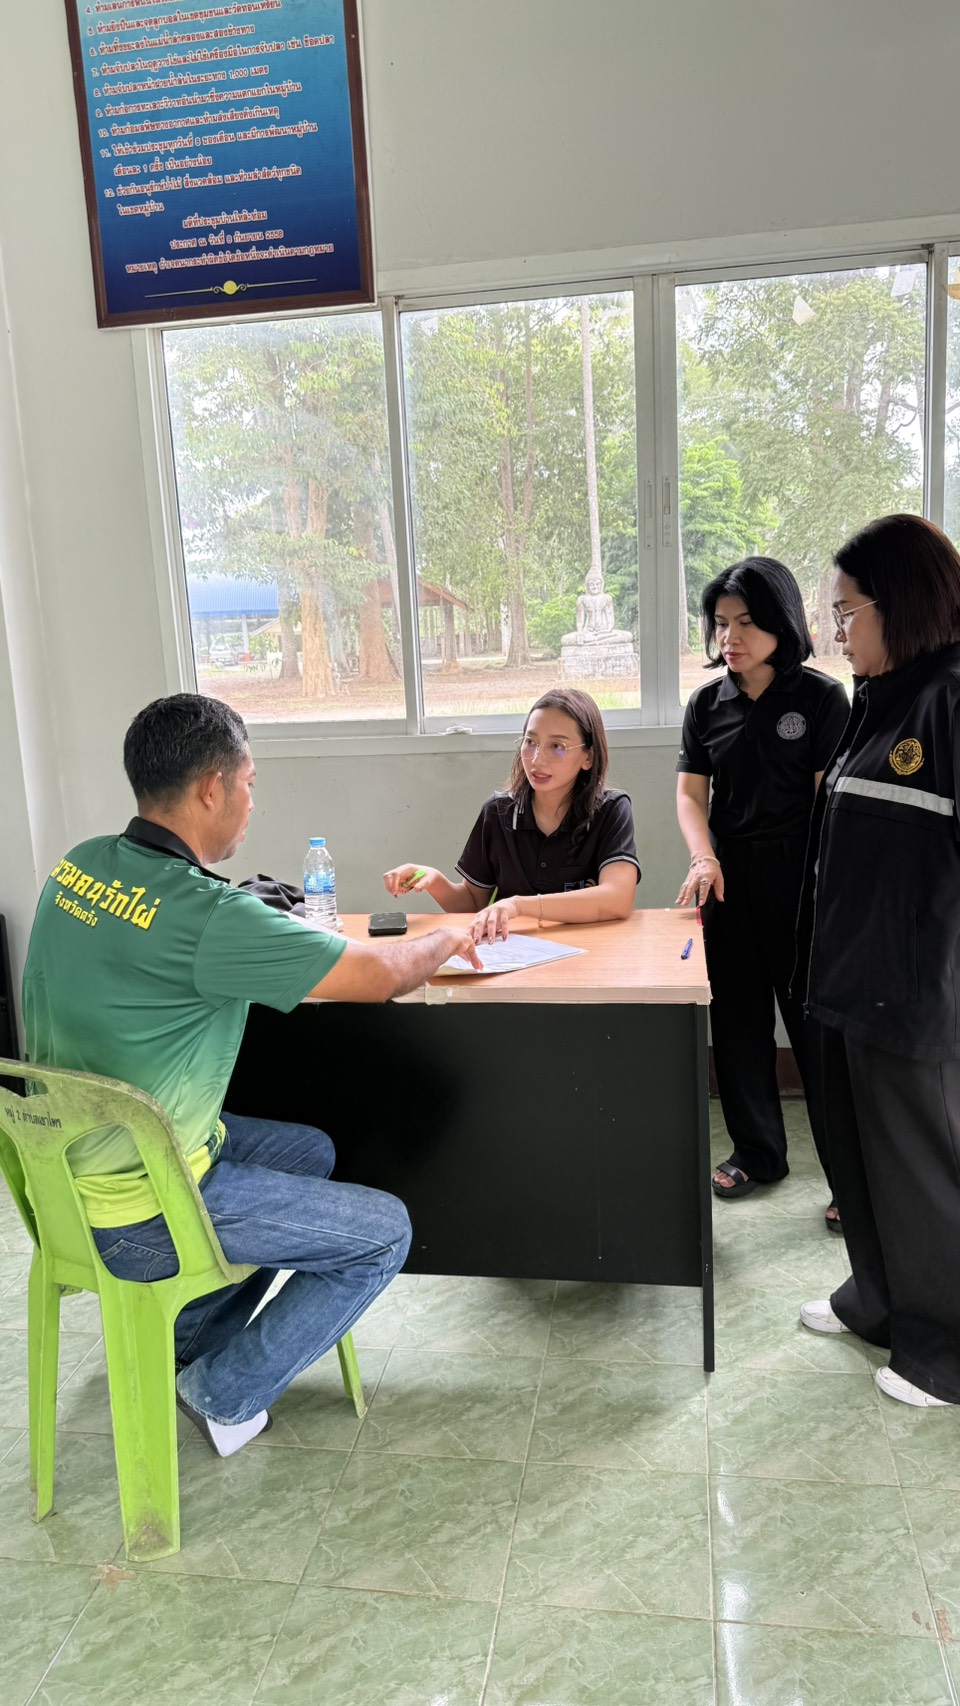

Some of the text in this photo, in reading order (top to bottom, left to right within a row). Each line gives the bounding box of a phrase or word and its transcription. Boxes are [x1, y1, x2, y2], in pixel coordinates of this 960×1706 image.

[88, 27, 95, 36] 5.
[89, 48, 97, 57] 6.
[92, 68, 100, 77] 7.
[287, 36, 301, 50] เช่น
[94, 89, 102, 98] 8.
[250, 65, 269, 77] เมตร
[96, 109, 103, 118] 9.
[98, 129, 109, 138] 10.
[101, 149, 112, 157] 11.
[194, 136, 201, 146] 8
[202, 128, 236, 146] ของเดือน
[237, 120, 318, 142] และมีการพัฒนาหมู่บ้าน
[114, 153, 213, 177] เดือนละ 1 ครั้ง เป็นอย่างน้อย
[105, 163, 302, 198] 12. ช่วยกันอนุรักษ์ป่าไม้ สิ่งแวดล้อม และห้ามล่าสัตว์ทุกชนิด
[117, 201, 165, 217] ในเขตหมู่บ้าน
[170, 238, 198, 251] ประกาศ
[198, 236, 208, 247] ณ
[209, 230, 225, 246] วันที่
[233, 231, 265, 244] กันยายน
[265, 229, 285, 241] 2558
[125, 259, 157, 274] หมายเหตุ
[54, 890, 99, 927] จังหวัดตรัง
[16, 1110, 21, 1120] 2
